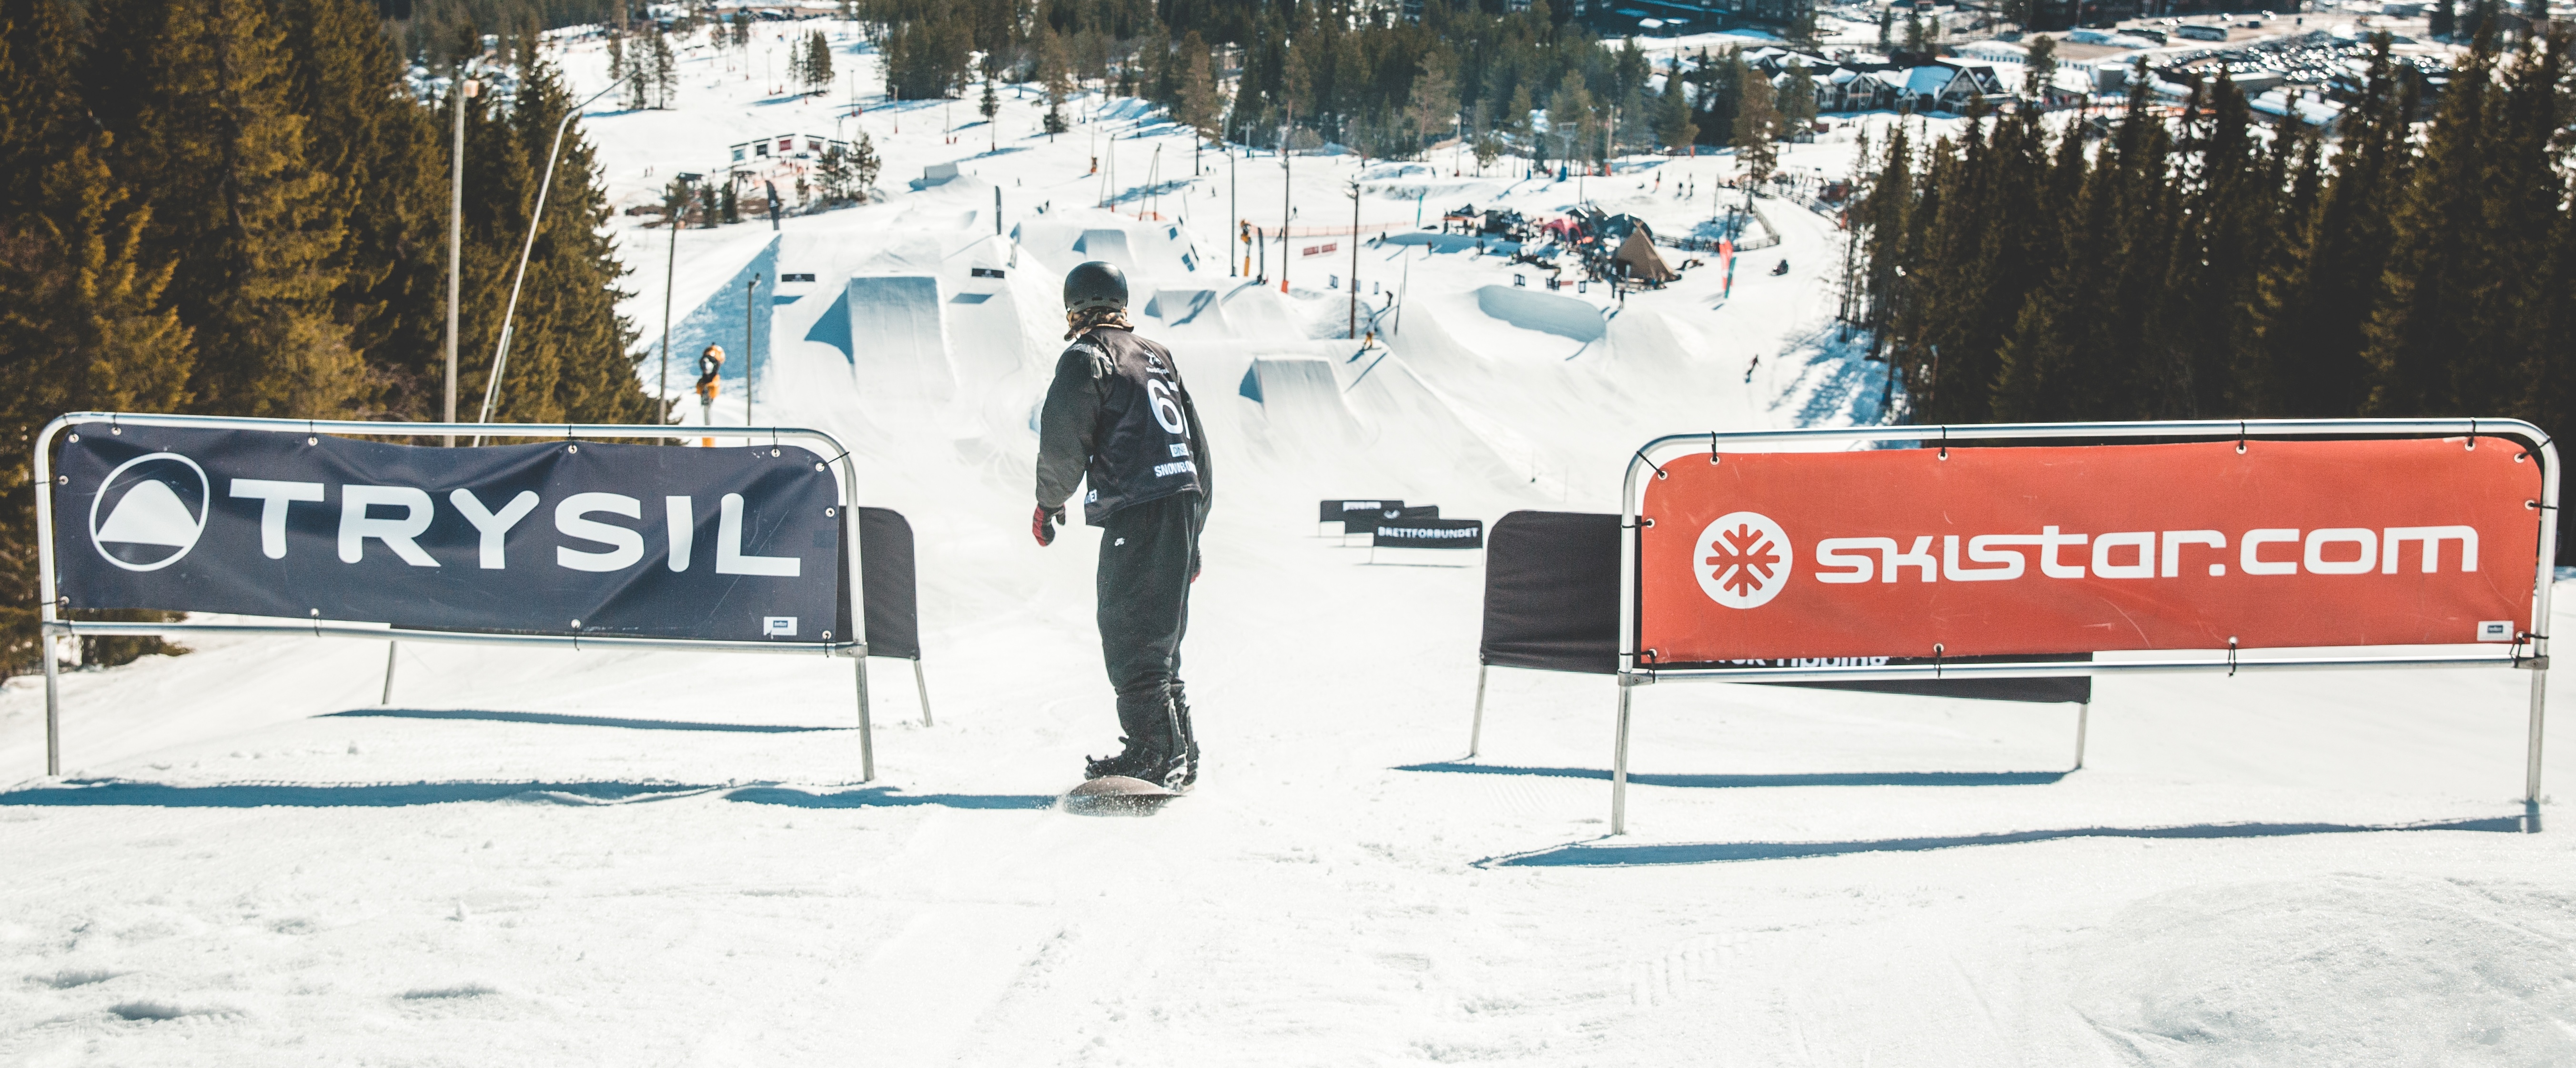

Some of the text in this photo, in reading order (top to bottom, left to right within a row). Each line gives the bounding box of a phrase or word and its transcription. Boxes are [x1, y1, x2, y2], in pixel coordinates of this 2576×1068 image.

[1154, 461, 1197, 477] SNOWBO
[230, 478, 801, 577] TRYSIL
[1377, 526, 1479, 539] BRETTFORBUNDET
[1815, 525, 2478, 584] skistar.com
[1777, 655, 1890, 667] ipping
